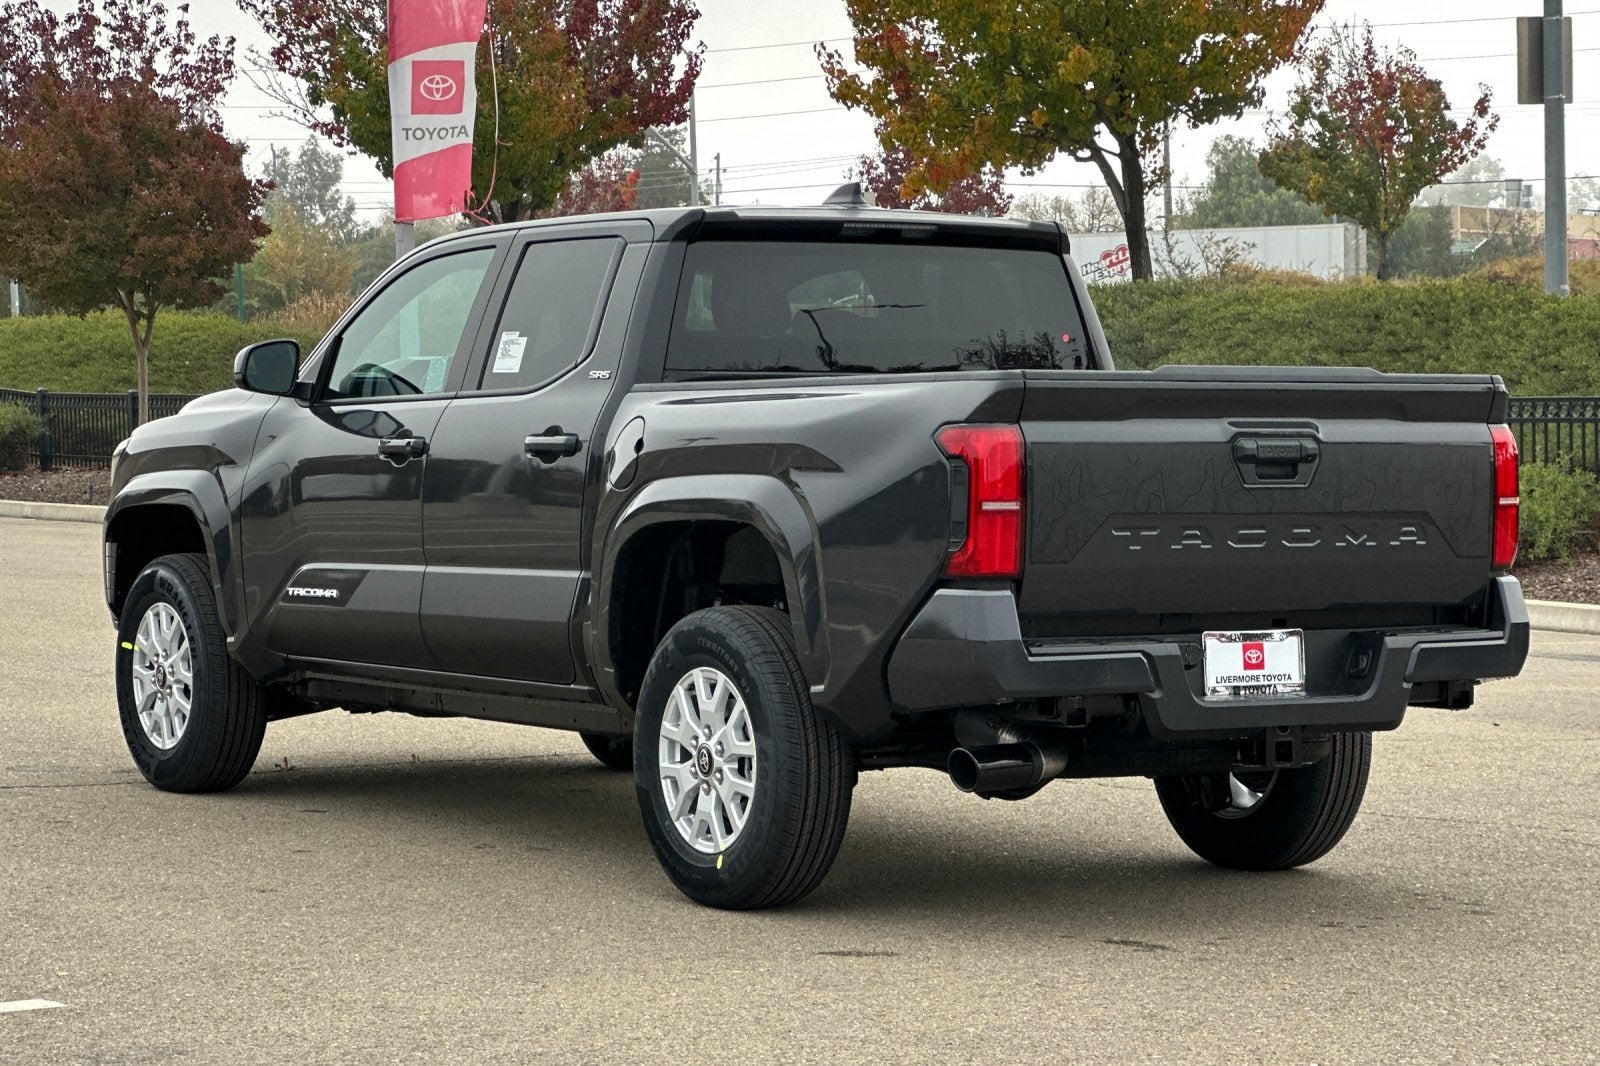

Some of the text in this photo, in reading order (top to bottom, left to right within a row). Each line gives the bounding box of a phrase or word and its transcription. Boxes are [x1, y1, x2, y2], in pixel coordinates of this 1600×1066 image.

[402, 125, 469, 141] TOYOTA
[1080, 250, 1130, 277] HeartL
[589, 370, 611, 379] SR5
[1111, 523, 1428, 550] TACOMA
[286, 587, 338, 598] TACOMA
[1216, 674, 1292, 684] LIVERMORE TOYOTA
[1243, 685, 1279, 695] TOYOTA
